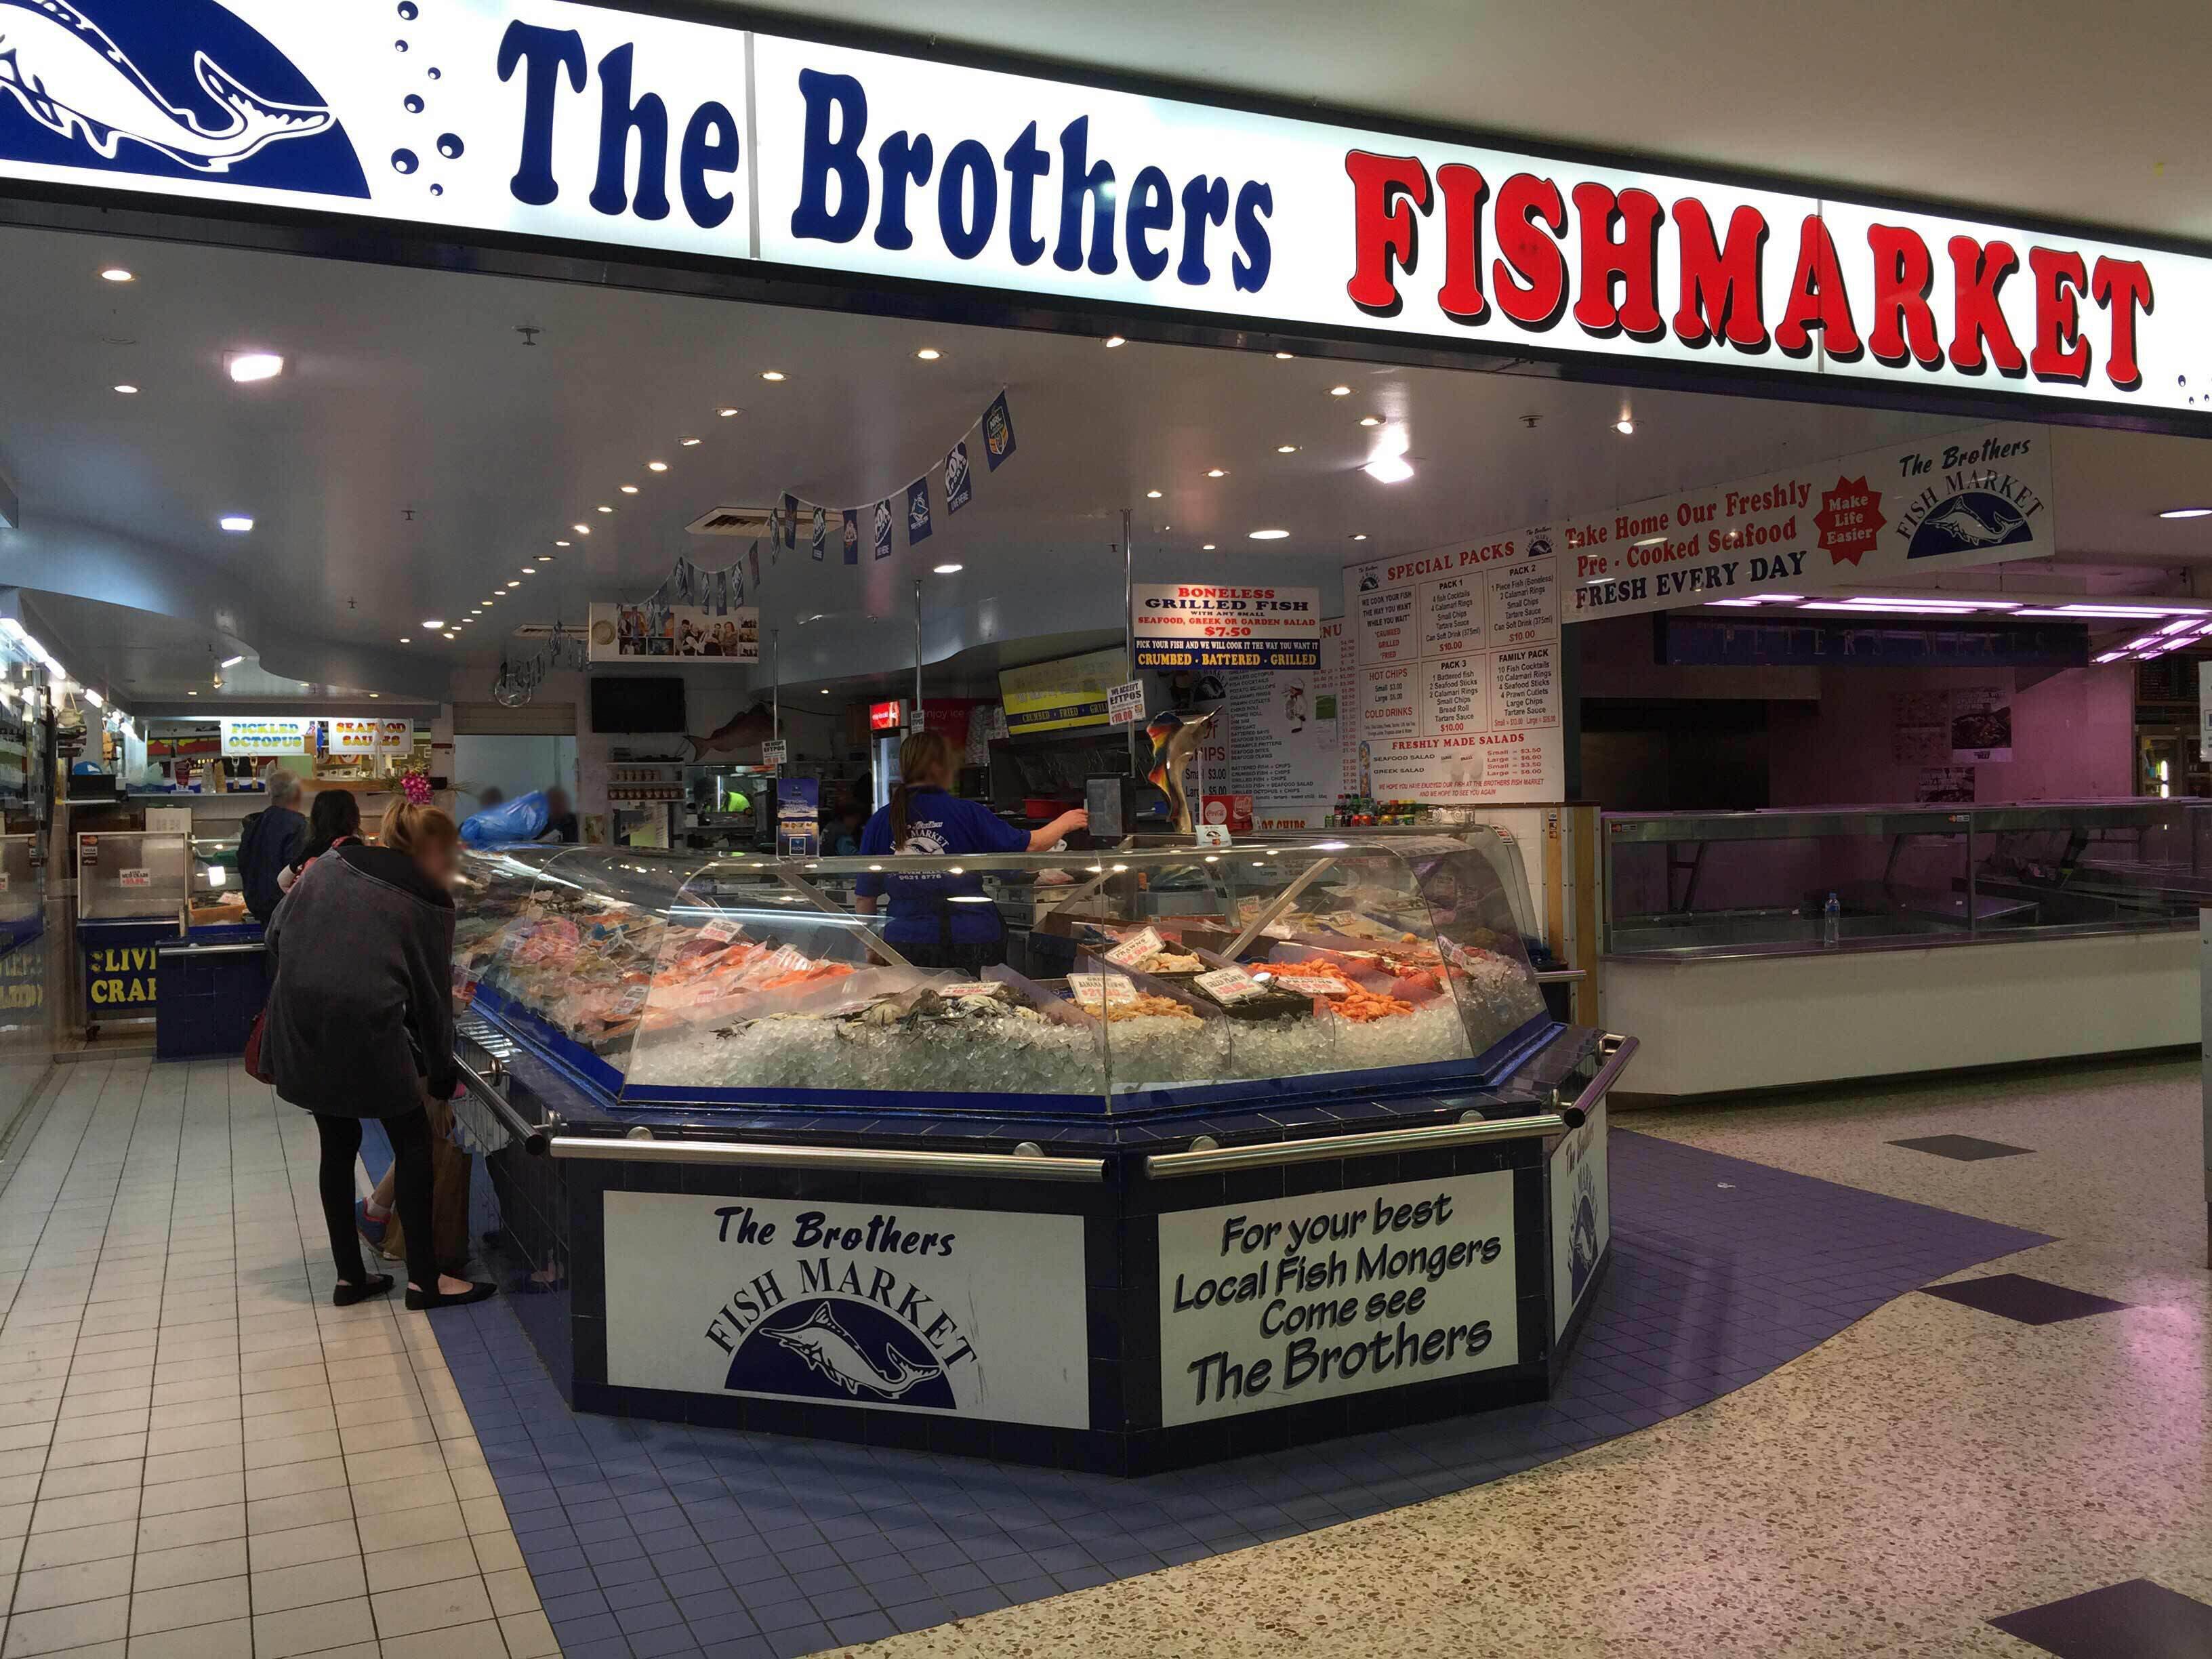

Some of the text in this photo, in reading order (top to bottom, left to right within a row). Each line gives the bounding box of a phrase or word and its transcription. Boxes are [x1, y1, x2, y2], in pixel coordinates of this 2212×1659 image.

[496, 18, 2154, 392] The Brothers FISHMARKET
[1900, 438, 2030, 477] The Brothers
[1829, 495, 1869, 512] Make
[1897, 469, 2044, 540] FISH MARKET
[1565, 525, 1607, 550] Take
[1615, 516, 1668, 540] Home
[1677, 503, 1717, 527] Our
[1725, 480, 1812, 518] Freshly
[1835, 512, 1864, 527] Life
[1826, 527, 1874, 546] Easier
[1577, 515, 1797, 577] Pre Cooked Seafood
[1387, 554, 1454, 581] SPECIAL
[1459, 541, 1515, 567] PACKS
[1509, 565, 1536, 576] PACK 2
[1439, 579, 1458, 590] PACK
[1512, 579, 1523, 588] Fish
[1575, 550, 1807, 609] FRESH EVERY DAY
[1178, 588, 1275, 599] BONELESS
[1145, 598, 1309, 611] GRILLED FISH
[1507, 598, 1540, 609] Small Chips
[1138, 617, 1186, 626] SEAFOOD,
[1204, 626, 1252, 637] $7.50
[1509, 630, 1536, 642] $10.00
[1136, 640, 1319, 651] PICK YOUR FISH AND WE WILL COOK IT THE WAY YOU WANT IT
[1439, 641, 1462, 651] $10.00
[1138, 653, 1317, 666] CRUMBED BATTERED GRILLED
[1499, 649, 1549, 662] FAMILY PACK
[1441, 660, 1460, 670] PACK
[1521, 661, 1551, 671] Cocktails
[1369, 668, 1408, 681] HOT CHIPS
[1505, 672, 1532, 681] Calamari
[1534, 671, 1552, 679] Rings
[1119, 683, 1139, 694] ACCEPT
[1434, 681, 1458, 689] Seafood
[1504, 682, 1530, 690] Seafood
[1109, 690, 1142, 705] EFTPOS
[1434, 689, 1460, 698] Calamari
[1454, 696, 1471, 704] Chips
[1525, 698, 1544, 706] Chips
[924, 710, 948, 720] njoy
[1058, 706, 1080, 719] FRIED
[1365, 707, 1413, 719] COLD DRINKS
[1527, 707, 1547, 715] Sauce
[231, 722, 300, 734] PICKLED
[335, 722, 407, 733] SEAFOD
[1440, 722, 1464, 732] $10.00
[228, 736, 302, 747] OCTOPUS
[342, 735, 401, 747] SAUES
[1392, 733, 1525, 750] FRESHLY MADE SALADS
[1189, 747, 1226, 762] HIPS
[1186, 768, 1226, 780] Smal $3.00
[910, 828, 949, 848] MARKET
[1220, 1193, 1454, 1256] For your best
[714, 1206, 956, 1257] The Brothers
[1173, 1235, 1502, 1313] Local Fish Mongers
[703, 1256, 978, 1370] FISH MARKET
[1258, 1286, 1427, 1339] Come see
[1186, 1318, 1492, 1406] The Brothers
